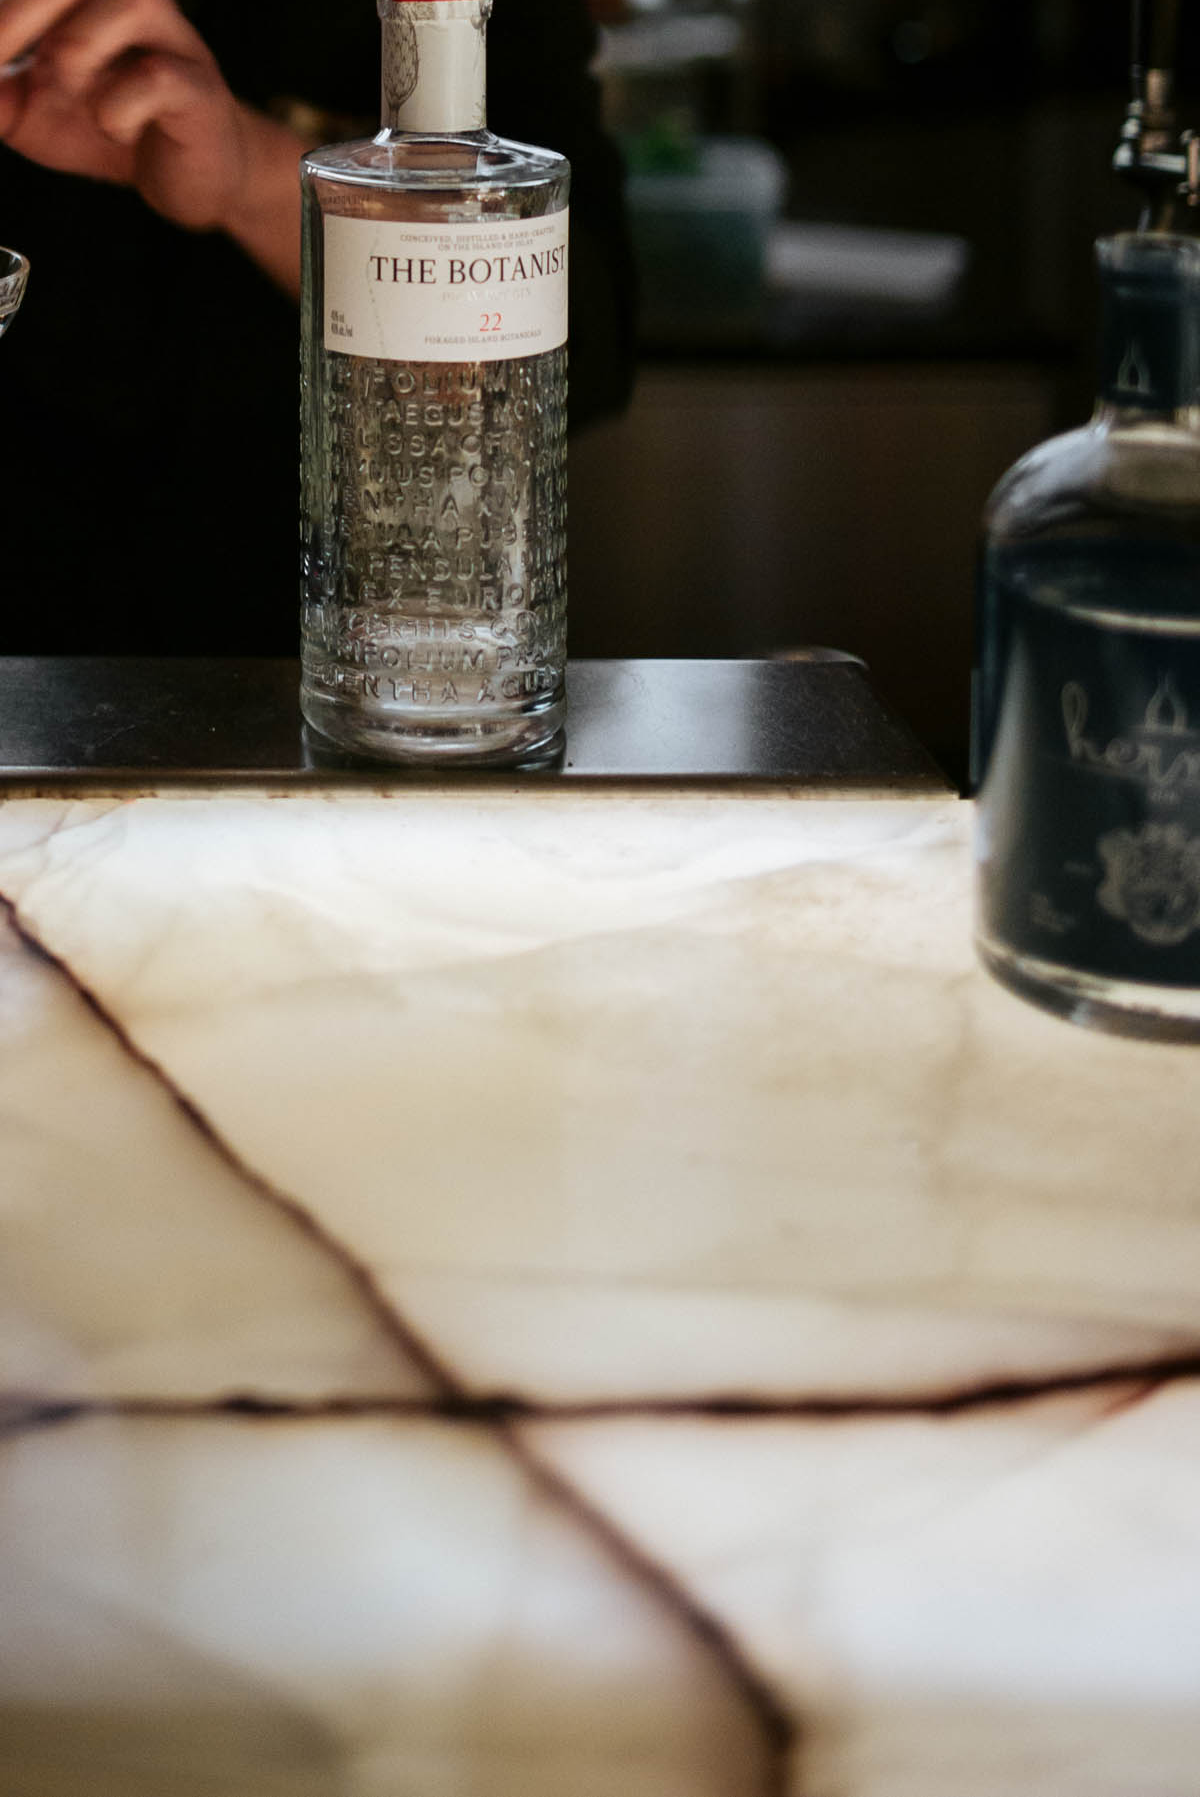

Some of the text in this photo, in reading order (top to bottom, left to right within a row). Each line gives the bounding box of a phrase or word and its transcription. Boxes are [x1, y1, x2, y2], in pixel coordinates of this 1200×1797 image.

[453, 243, 469, 251] THE
[370, 244, 566, 284] THE BOTANIST
[480, 312, 502, 331] 22
